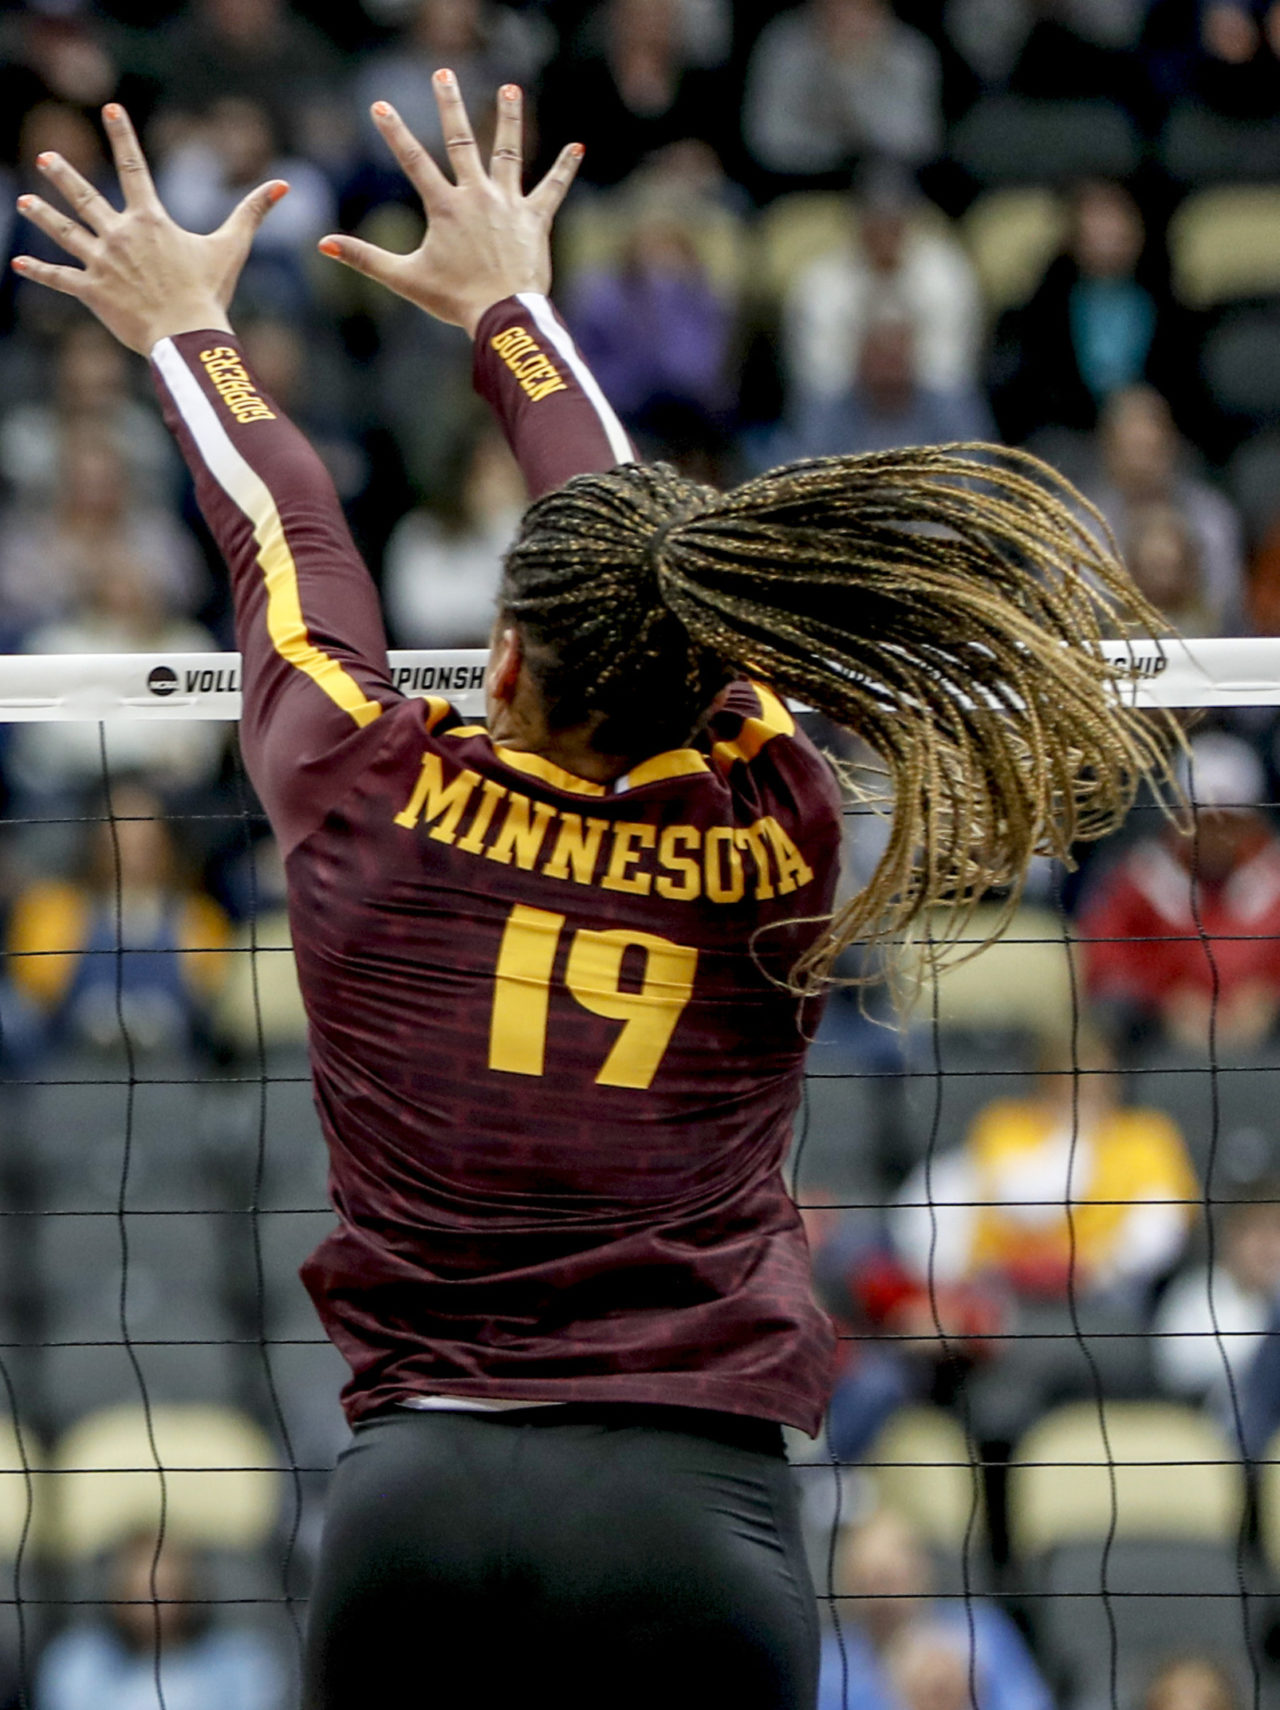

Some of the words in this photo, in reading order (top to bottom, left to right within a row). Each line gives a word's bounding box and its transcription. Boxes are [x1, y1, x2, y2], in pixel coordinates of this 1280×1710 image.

[200, 346, 277, 423] GOPHERS
[490, 326, 568, 402] GOLDEN
[185, 669, 243, 693] VOLL
[394, 752, 814, 903] MINNESOTA
[488, 903, 699, 1090] 19
